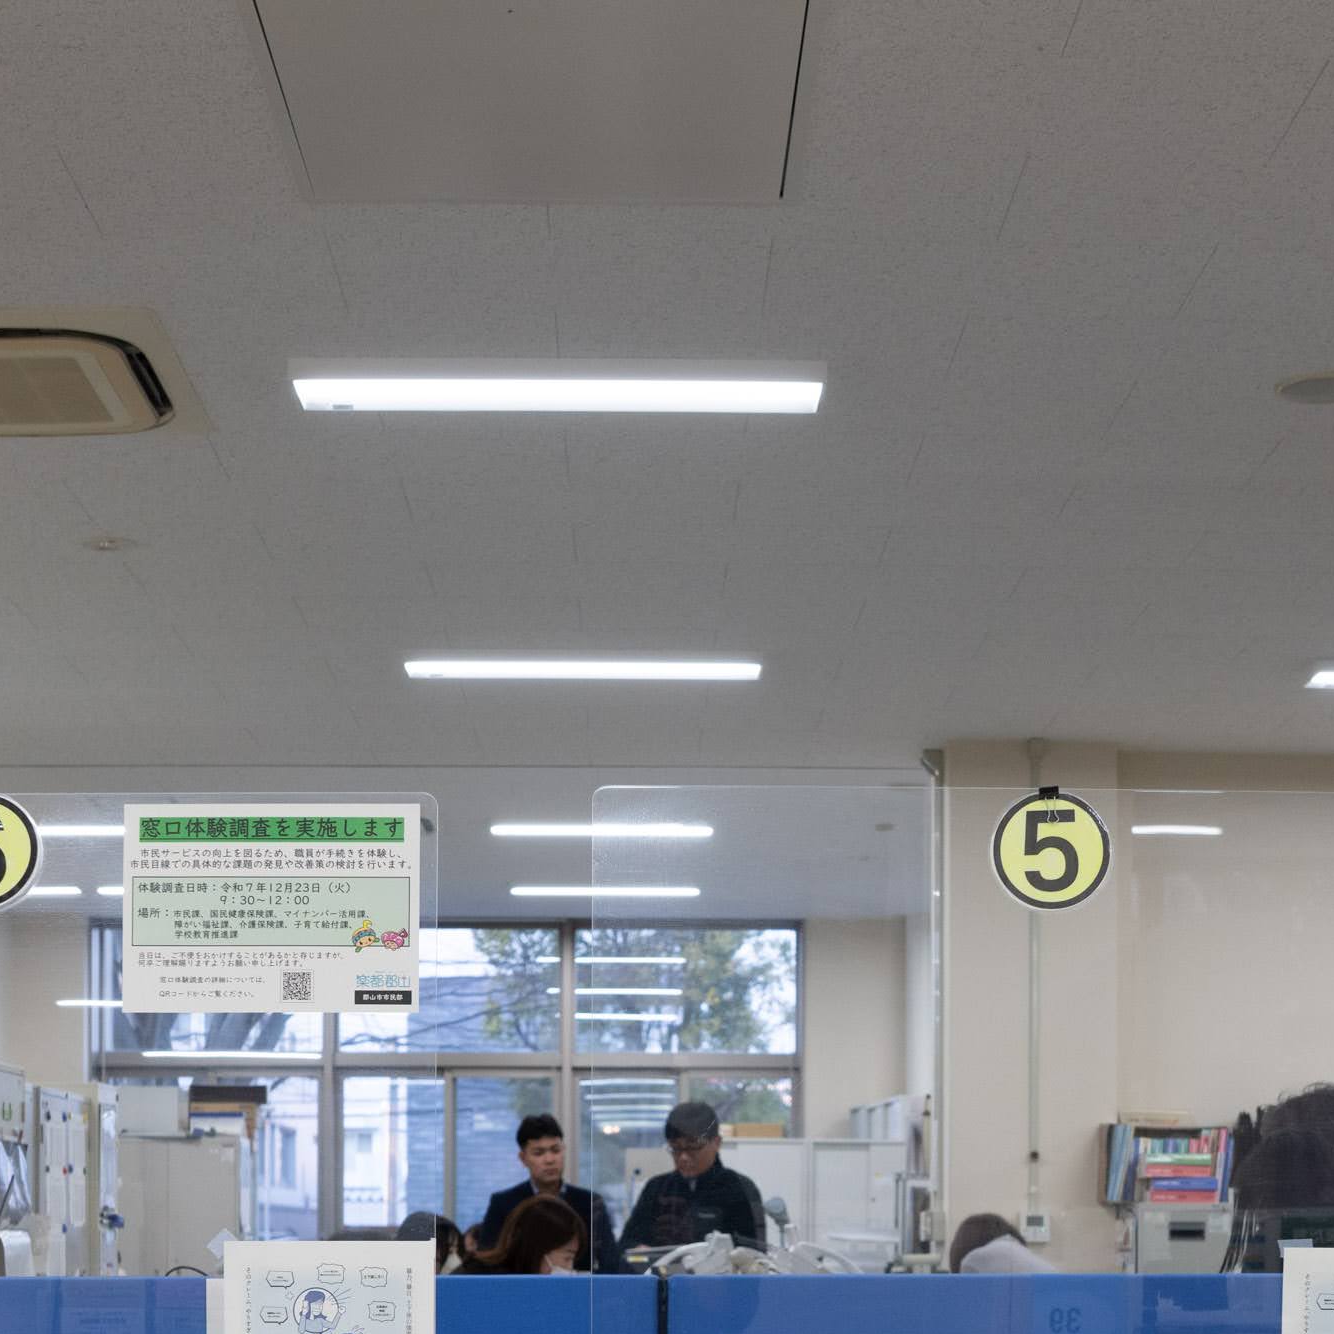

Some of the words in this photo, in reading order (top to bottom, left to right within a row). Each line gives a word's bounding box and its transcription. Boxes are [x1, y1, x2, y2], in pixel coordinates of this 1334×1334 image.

[141, 818, 403, 838] 窓口体験調査を実施します
[140, 849, 402, 859] 市民サービスの向上を図るため、職員が手続きを体験し、
[1024, 809, 1079, 892] 5
[130, 859, 411, 870] 市民目線での具体的な課題の発見や改善策の検討を行います。
[174, 921, 353, 929] 障がい福祉課、介護保険課、子育て給付課、
[175, 930, 238, 939] 学校教育推進課
